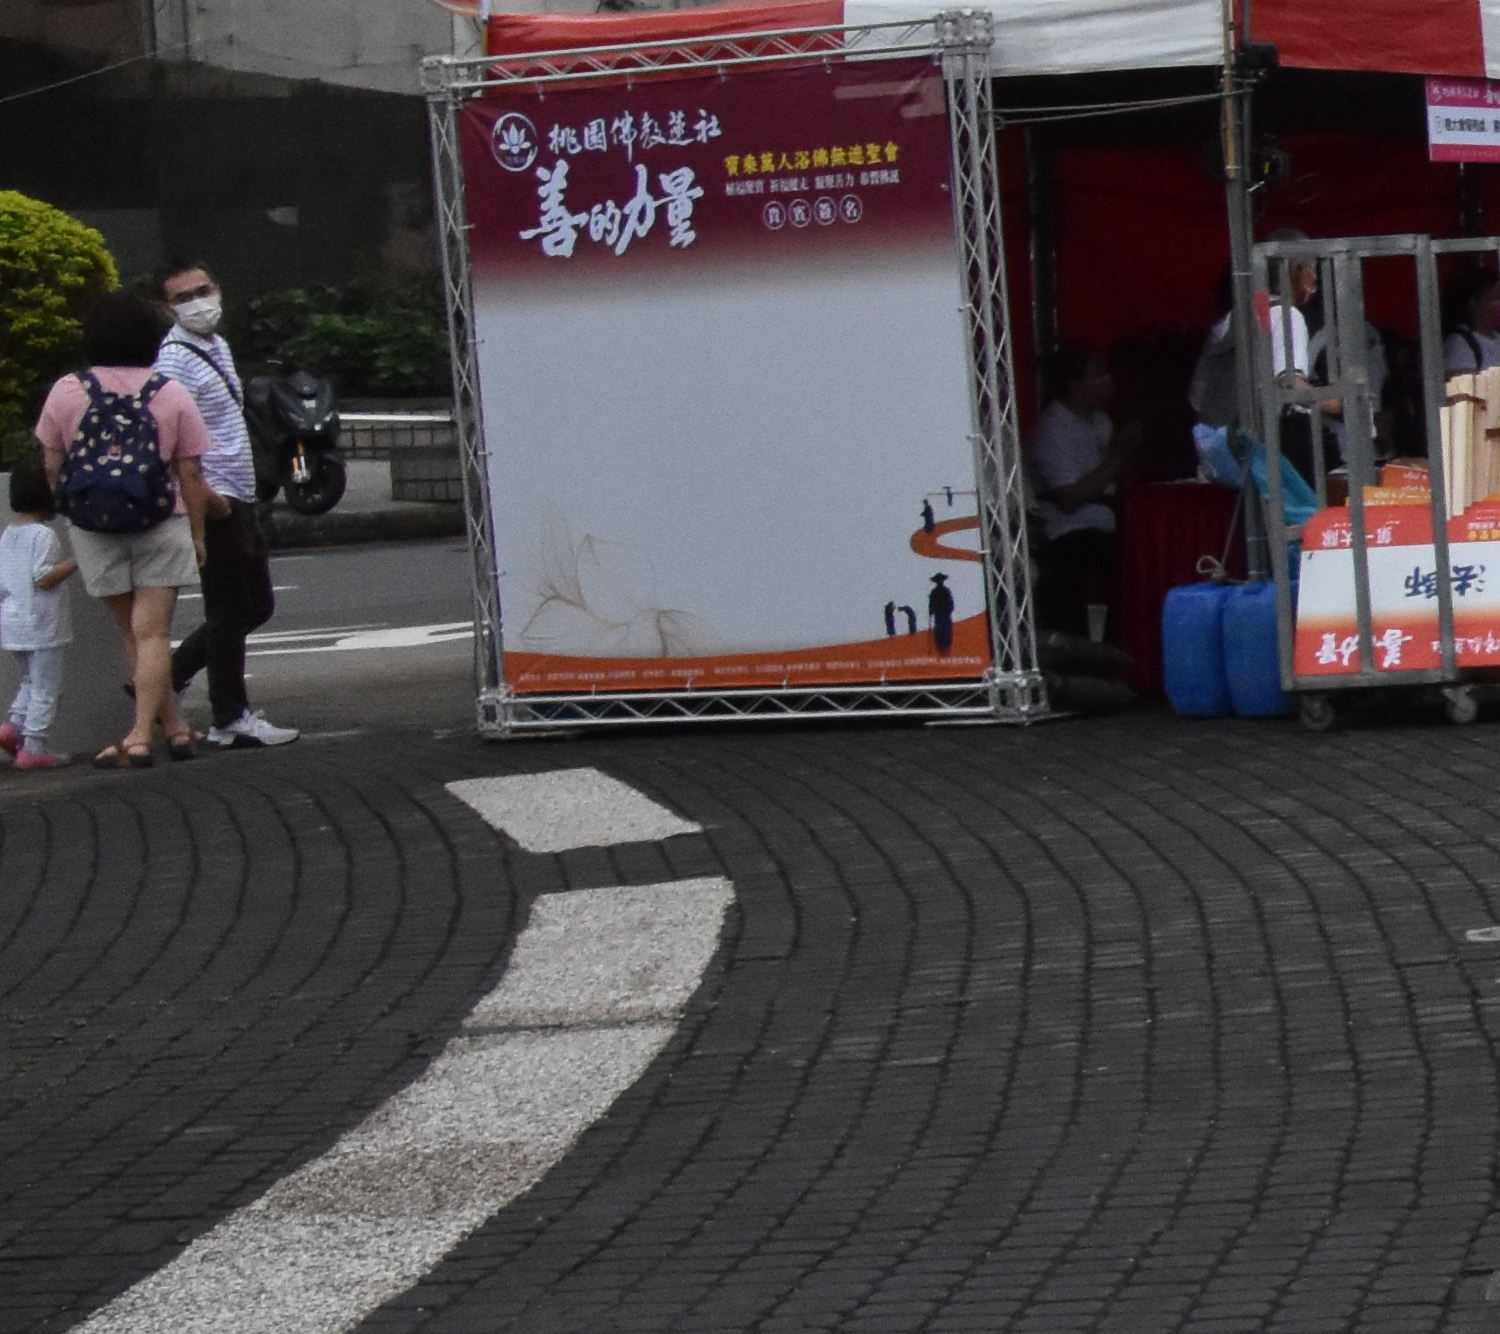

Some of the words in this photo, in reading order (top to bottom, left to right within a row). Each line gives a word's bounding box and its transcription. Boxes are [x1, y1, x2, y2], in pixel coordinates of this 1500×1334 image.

[548, 109, 724, 164] 桃園佛教蓮社
[519, 160, 704, 259] 善的力量
